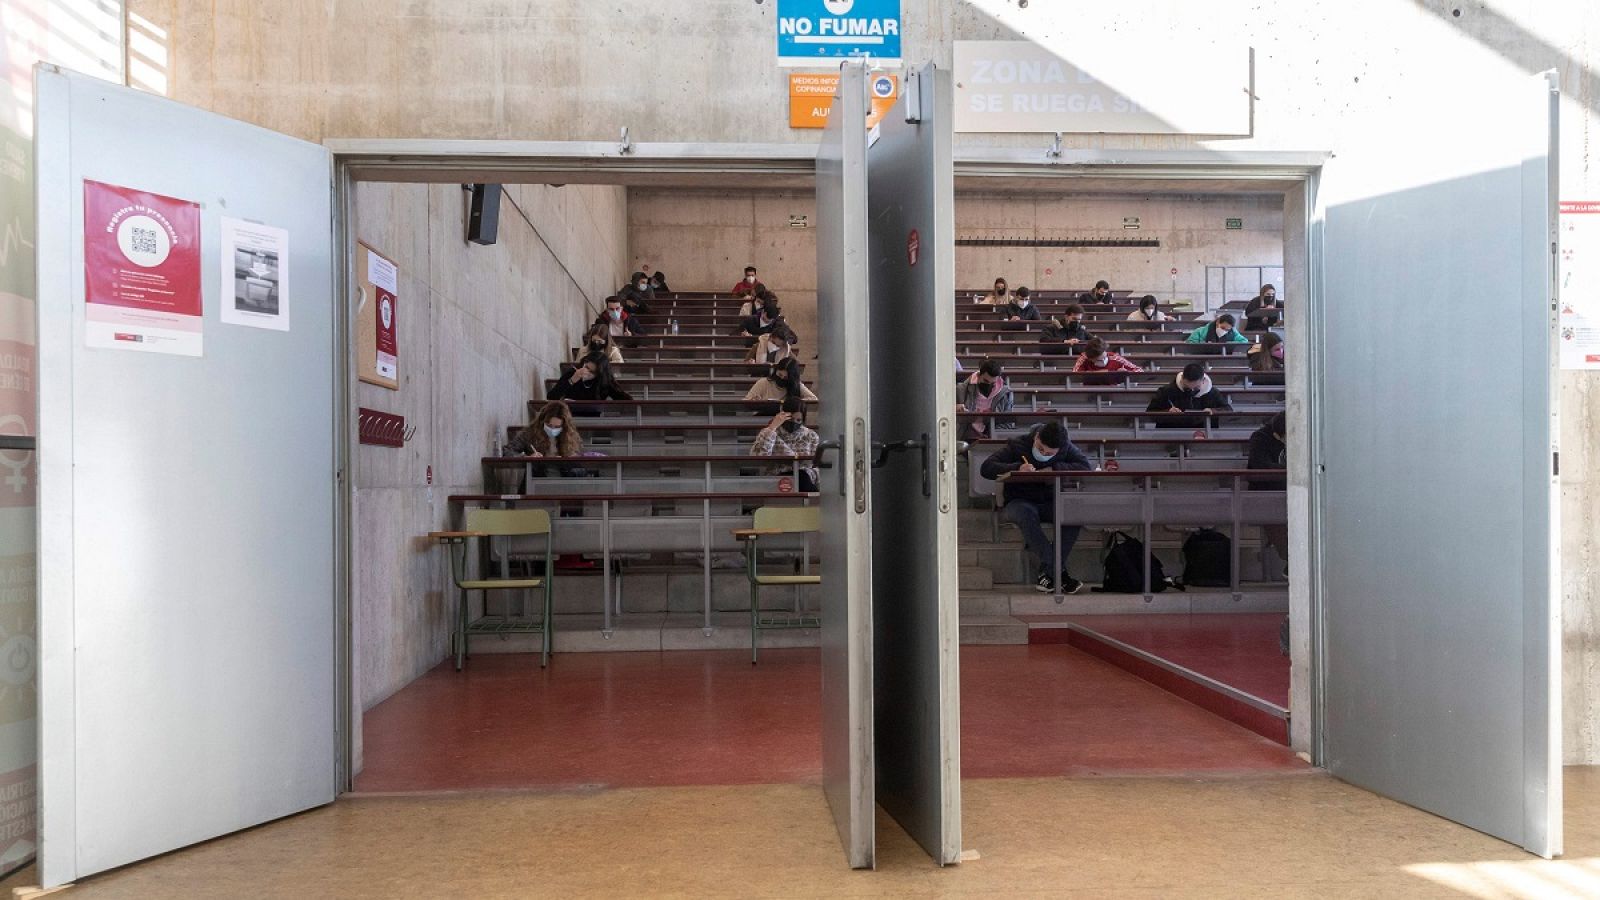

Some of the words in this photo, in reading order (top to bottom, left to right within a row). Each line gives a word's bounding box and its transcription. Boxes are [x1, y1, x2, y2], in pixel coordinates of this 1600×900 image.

[780, 17, 813, 35] NO
[819, 18, 898, 36] FUMAR
[972, 60, 1065, 83] ZONA
[969, 93, 1003, 112] SE
[1012, 93, 1104, 112] RUEGA
